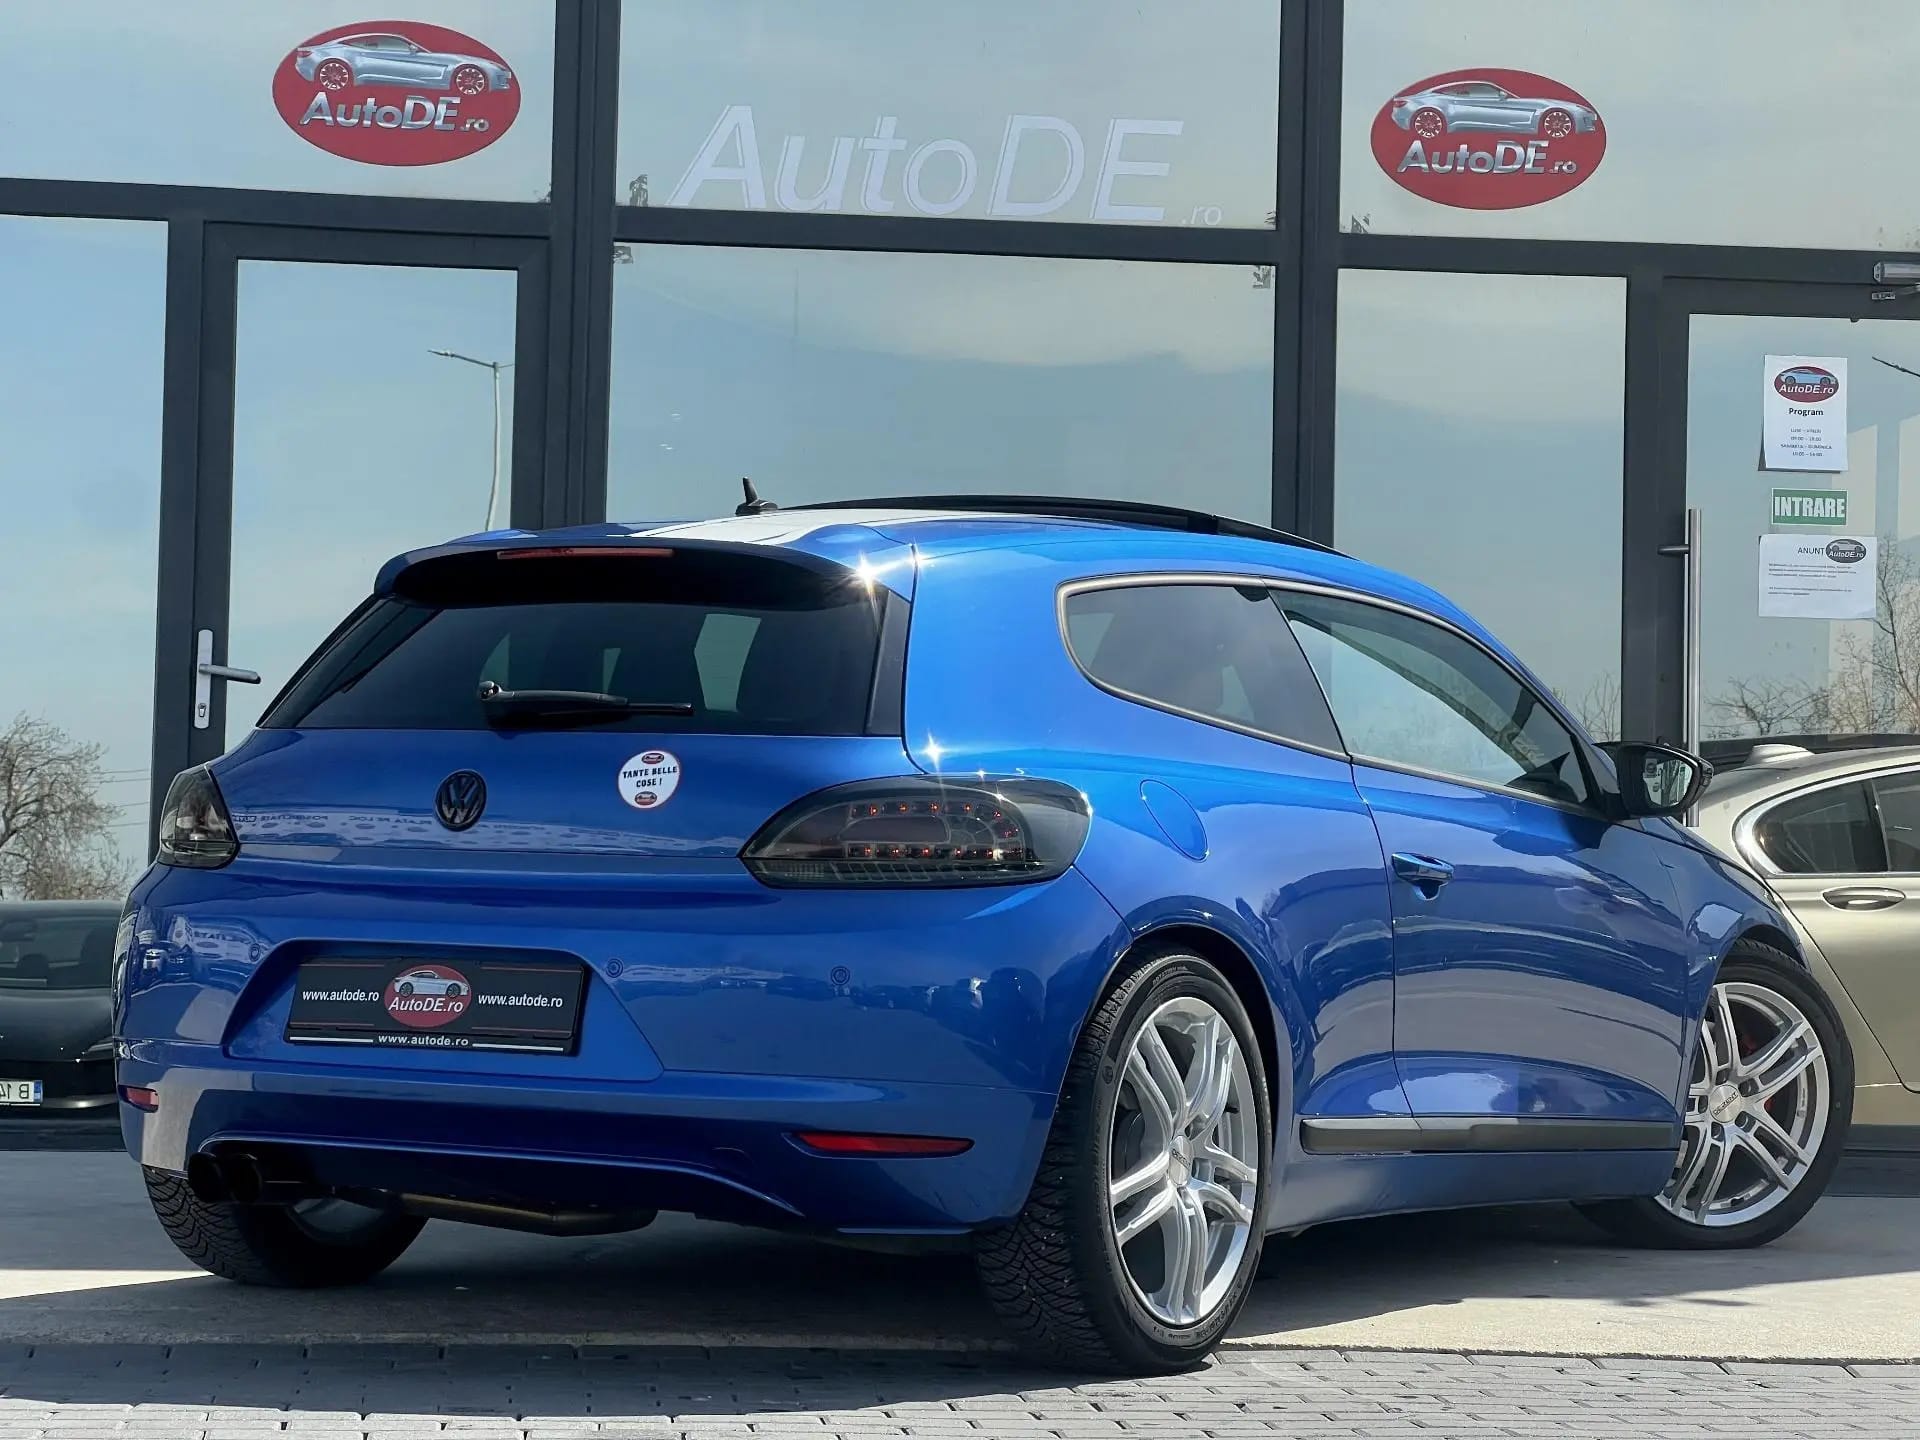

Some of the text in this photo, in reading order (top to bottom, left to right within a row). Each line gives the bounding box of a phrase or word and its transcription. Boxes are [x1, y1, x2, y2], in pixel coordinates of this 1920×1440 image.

[1779, 383, 1835, 394] AutoDE.ro
[1788, 407, 1824, 417] Program
[1774, 496, 1845, 518] INTRARE
[622, 766, 678, 779] TANTE BELLE
[636, 778, 657, 788] COSE
[302, 988, 379, 1002] www.autode.ro
[477, 992, 563, 1008] www.autode.ro
[388, 996, 464, 1014] AutoDE.ro
[377, 1033, 469, 1047] www.autode.ro
